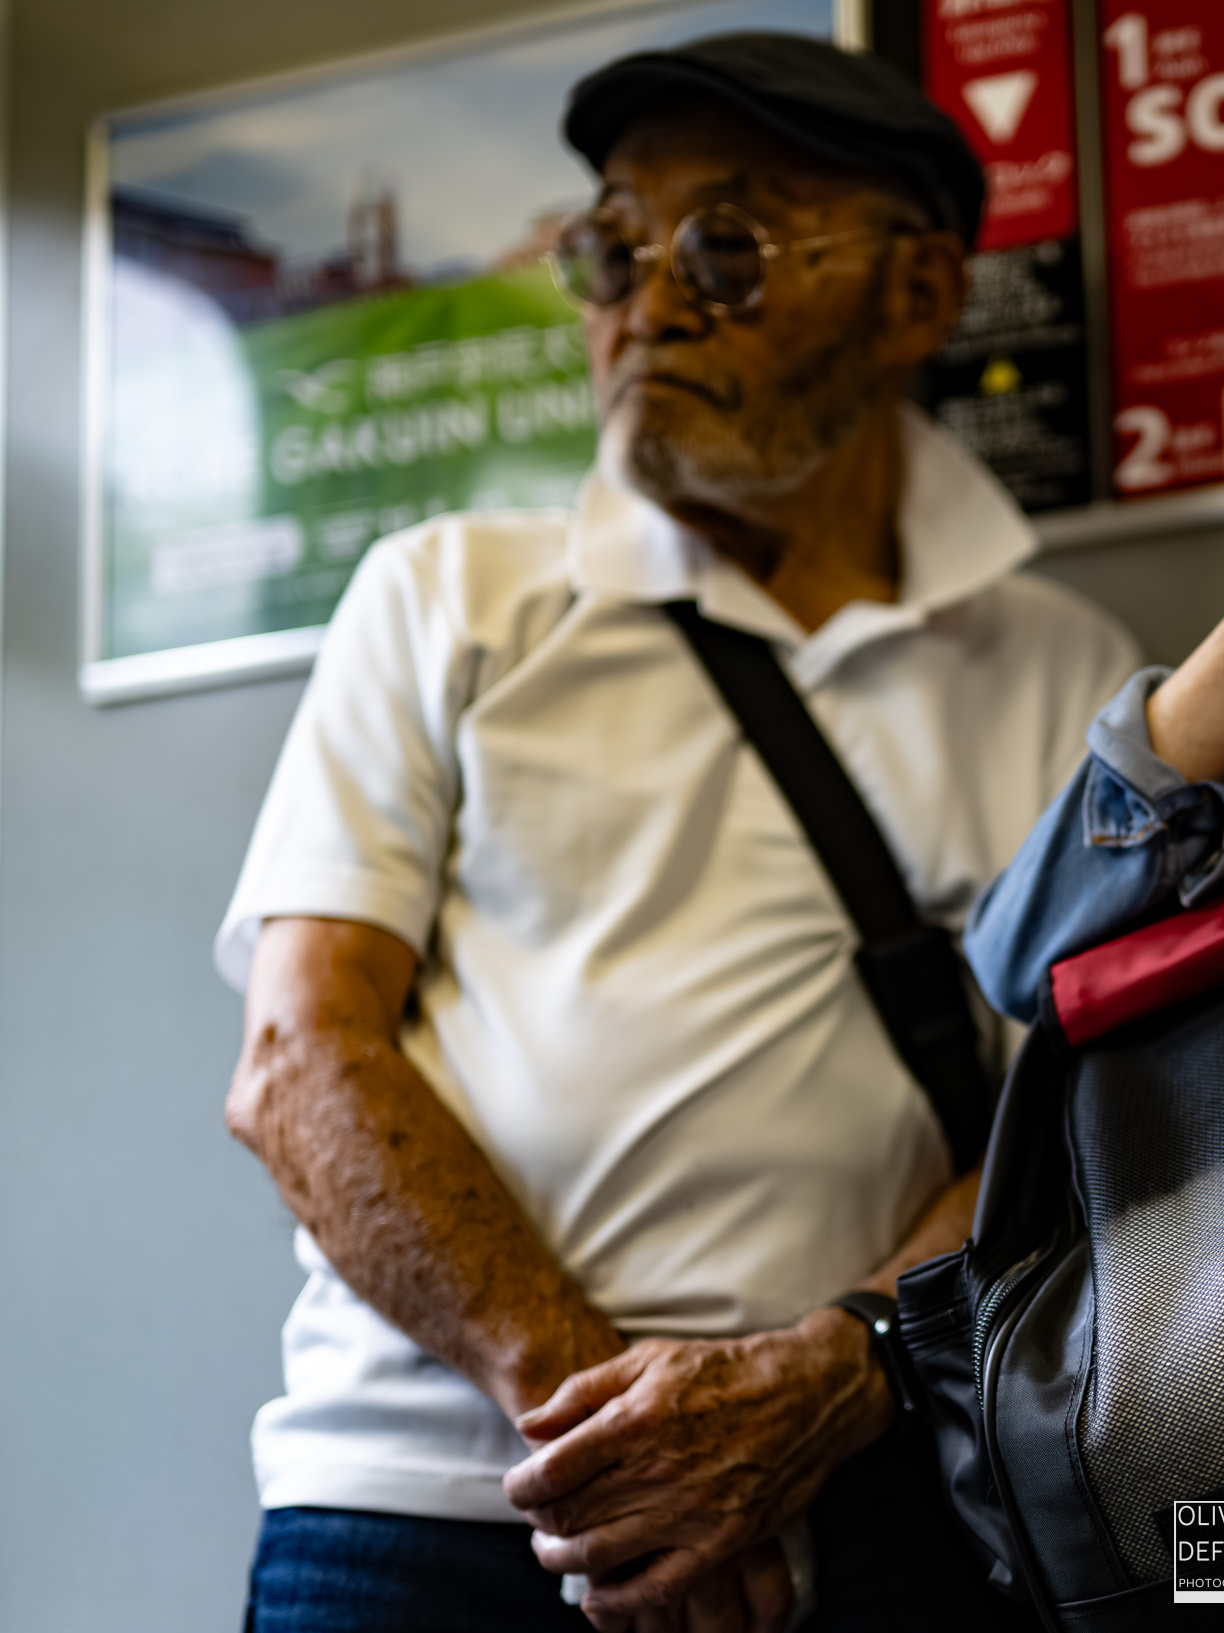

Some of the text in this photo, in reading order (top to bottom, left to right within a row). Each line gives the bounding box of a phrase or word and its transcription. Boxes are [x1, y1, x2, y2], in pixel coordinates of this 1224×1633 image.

[1104, 13, 1148, 91] 1
[497, 378, 593, 444] UNI
[1113, 406, 1173, 488] 2
